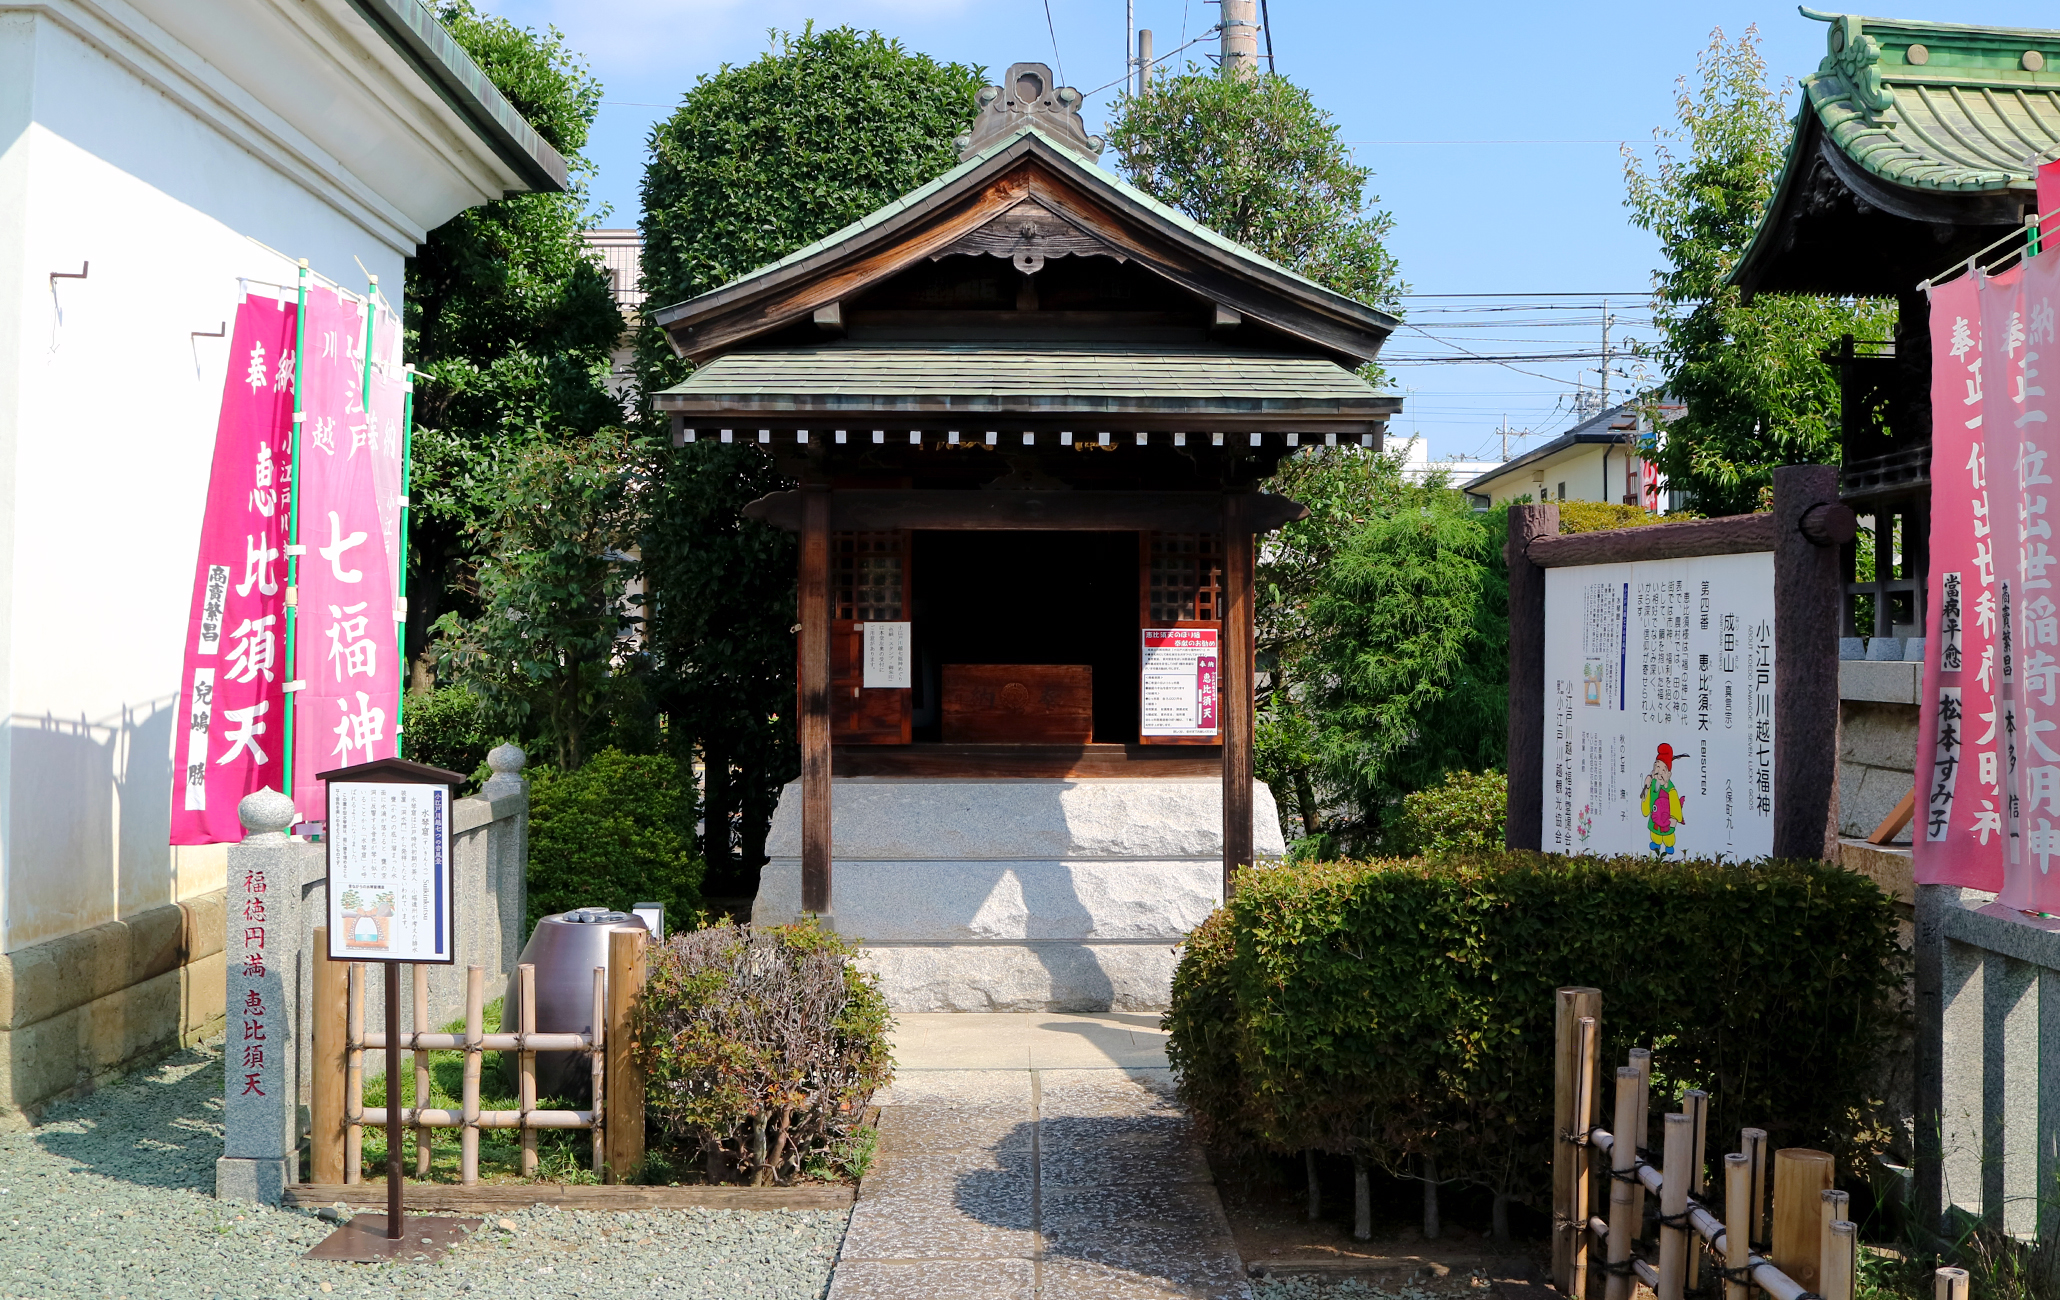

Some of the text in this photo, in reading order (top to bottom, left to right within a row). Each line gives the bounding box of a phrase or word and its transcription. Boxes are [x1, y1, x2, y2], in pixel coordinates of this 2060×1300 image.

[216, 440, 279, 766] 恵比須天
[319, 510, 386, 768] 七福神
[1700, 580, 1710, 630] 第四番
[1202, 672, 1212, 719] 恵比須天
[1698, 654, 1709, 731] 恵比須天
[1755, 618, 1771, 818] 小江戸川越七福神
[1926, 692, 1963, 839] 松本すみ子
[241, 989, 267, 1097] 恵比須天
